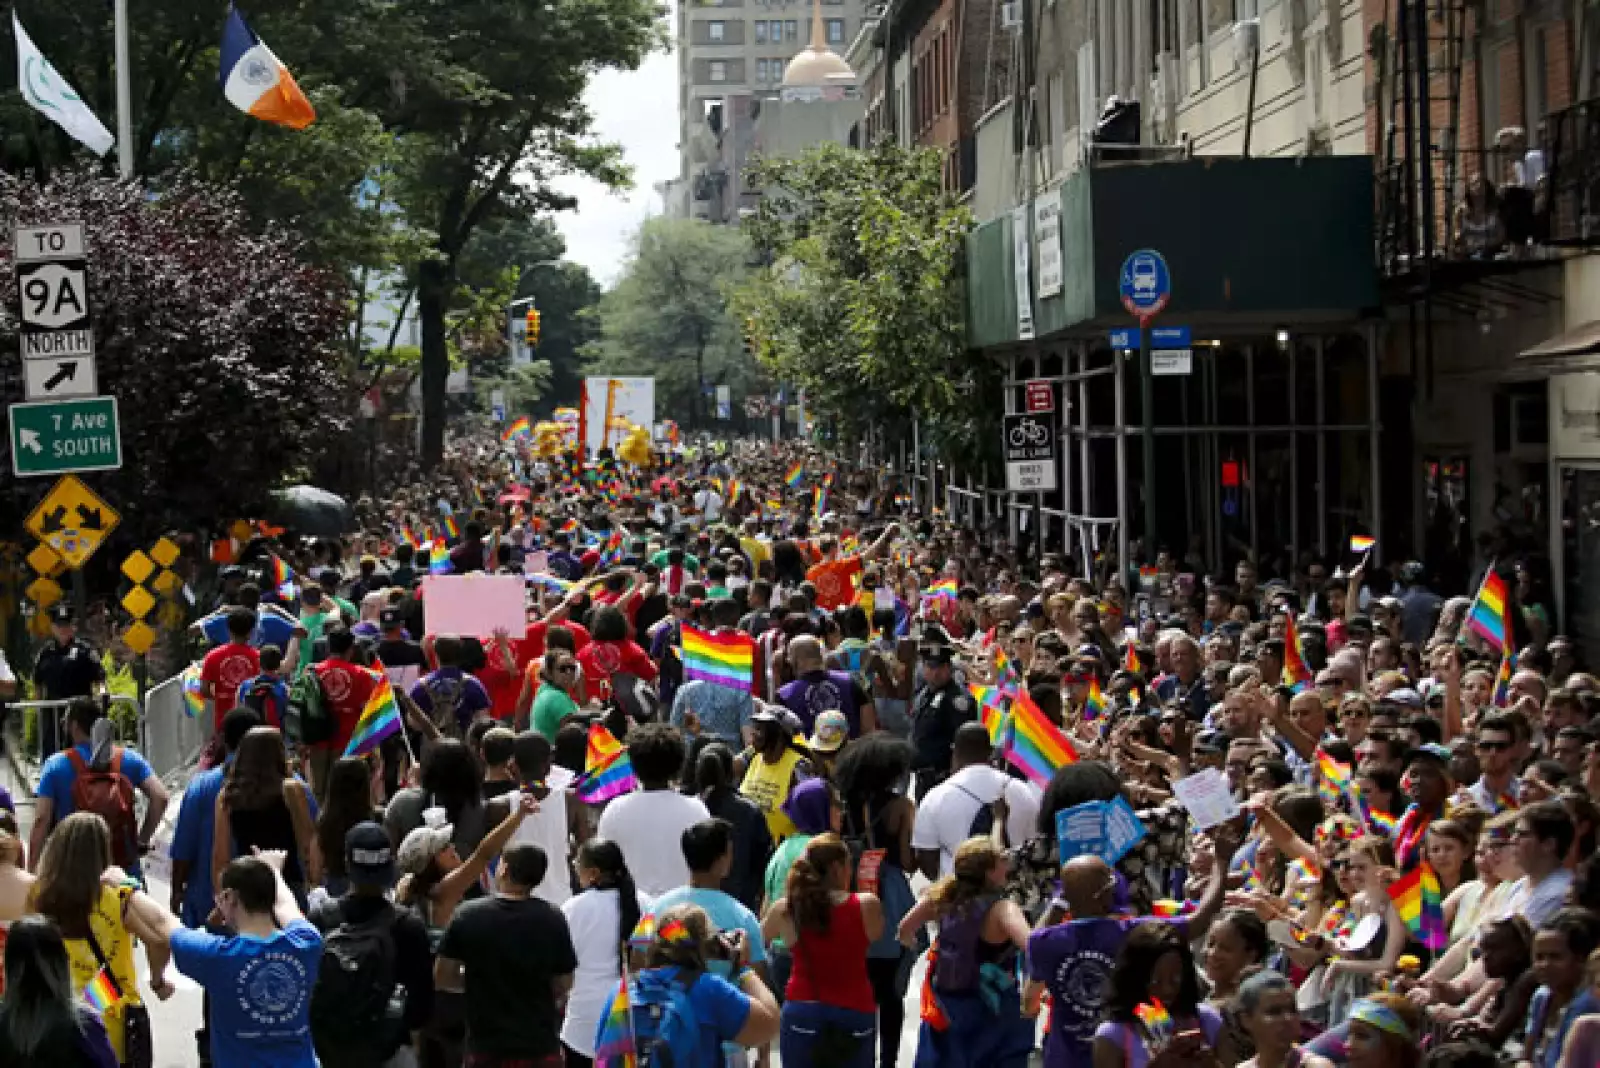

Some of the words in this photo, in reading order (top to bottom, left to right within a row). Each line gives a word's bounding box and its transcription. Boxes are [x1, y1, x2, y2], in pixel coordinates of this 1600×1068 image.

[33, 232, 65, 251] TO
[25, 277, 83, 315] 9A
[27, 332, 90, 353] NORTH
[52, 414, 64, 431] 7
[52, 436, 112, 457] SOUTH
